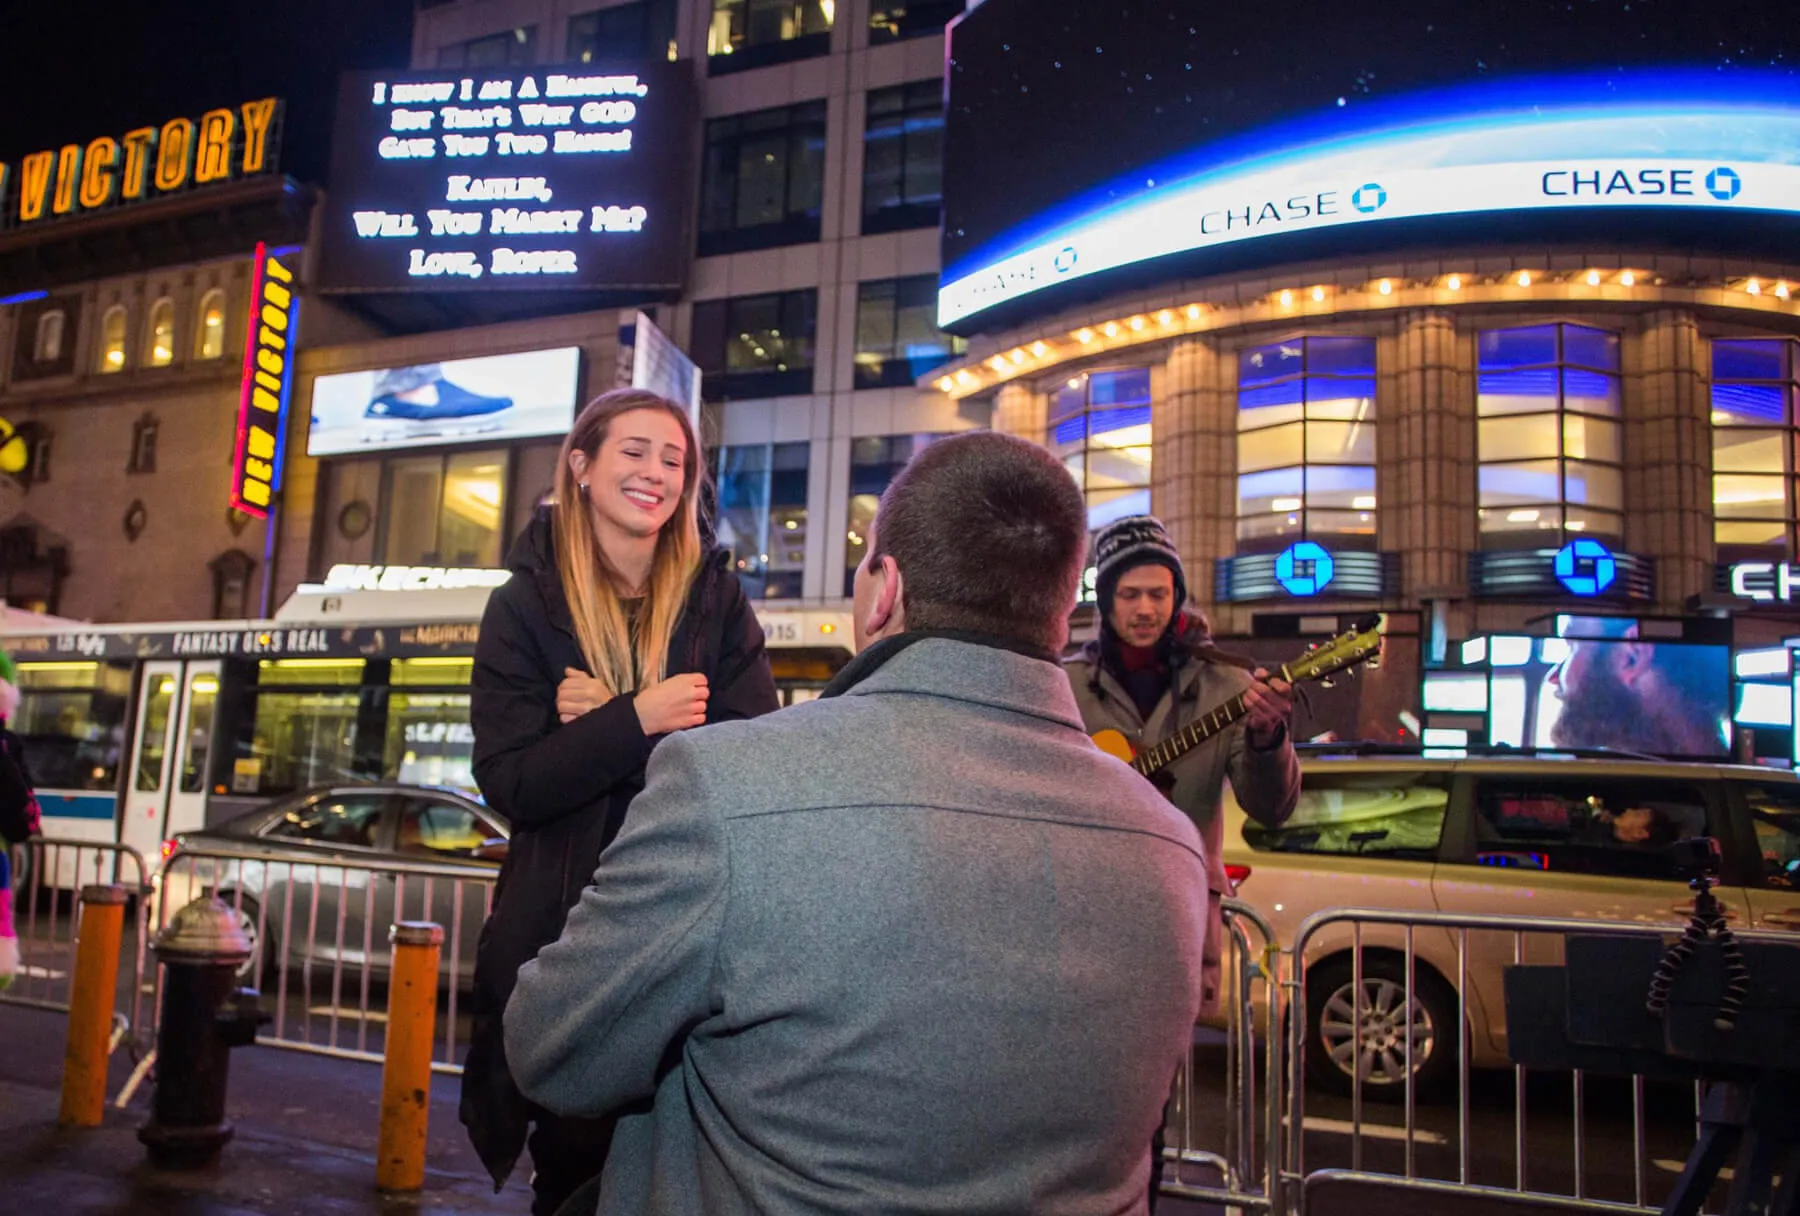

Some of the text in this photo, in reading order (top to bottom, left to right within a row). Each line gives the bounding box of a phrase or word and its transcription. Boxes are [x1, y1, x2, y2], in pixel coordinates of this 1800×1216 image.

[372, 82, 386, 104] I
[459, 78, 474, 101] I
[517, 76, 540, 98] A
[518, 103, 575, 126] WHY
[580, 100, 636, 124] GOD
[442, 134, 489, 157] YOU
[20, 98, 278, 222] VICTORY
[1542, 170, 1695, 196] CHASE
[353, 211, 419, 237] WILL
[427, 209, 483, 236] YOU
[1201, 191, 1339, 235] CHASE
[242, 256, 294, 507] NEW VICTORY
[172, 631, 239, 654] FANTASY
[287, 628, 329, 652] REAL
